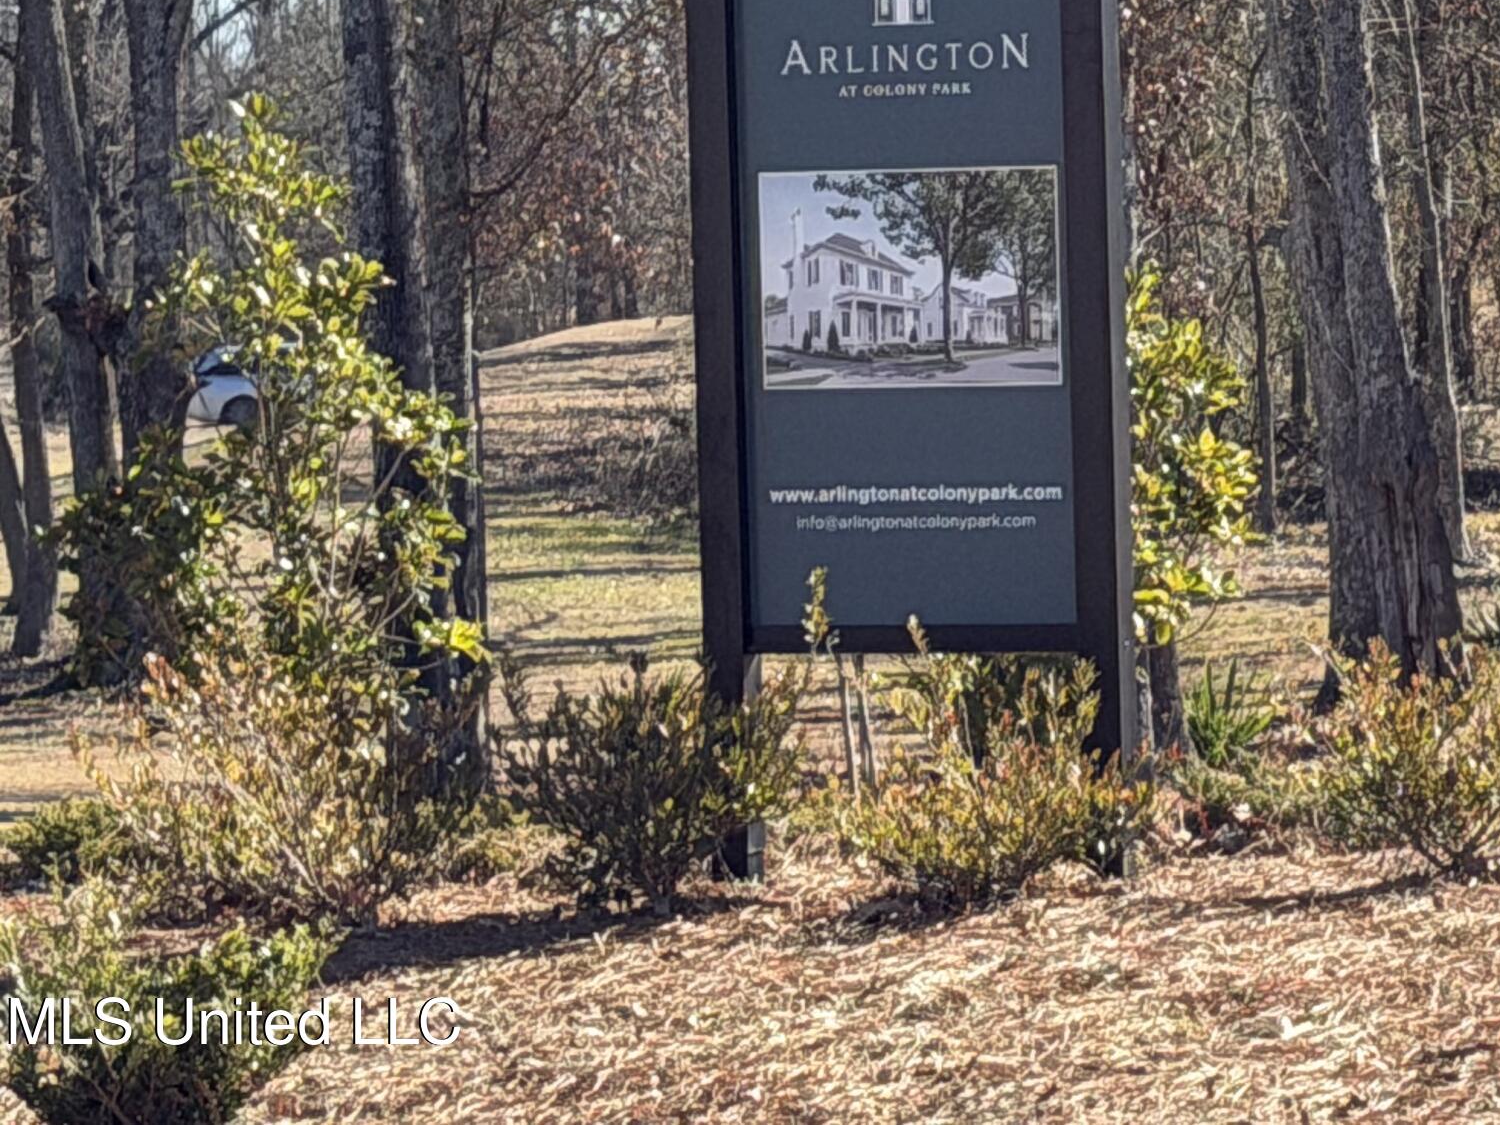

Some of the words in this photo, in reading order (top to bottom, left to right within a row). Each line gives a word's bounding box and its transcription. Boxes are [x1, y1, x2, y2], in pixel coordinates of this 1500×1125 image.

[780, 32, 1030, 76] ARLINGTON
[839, 85, 857, 98] AT
[863, 83, 927, 97] COLONY
[932, 82, 972, 95] PARK
[769, 483, 1063, 505] www.arlingtonatcolonypark.com
[796, 512, 1037, 532] info@arlingtonatcolonypark.com
